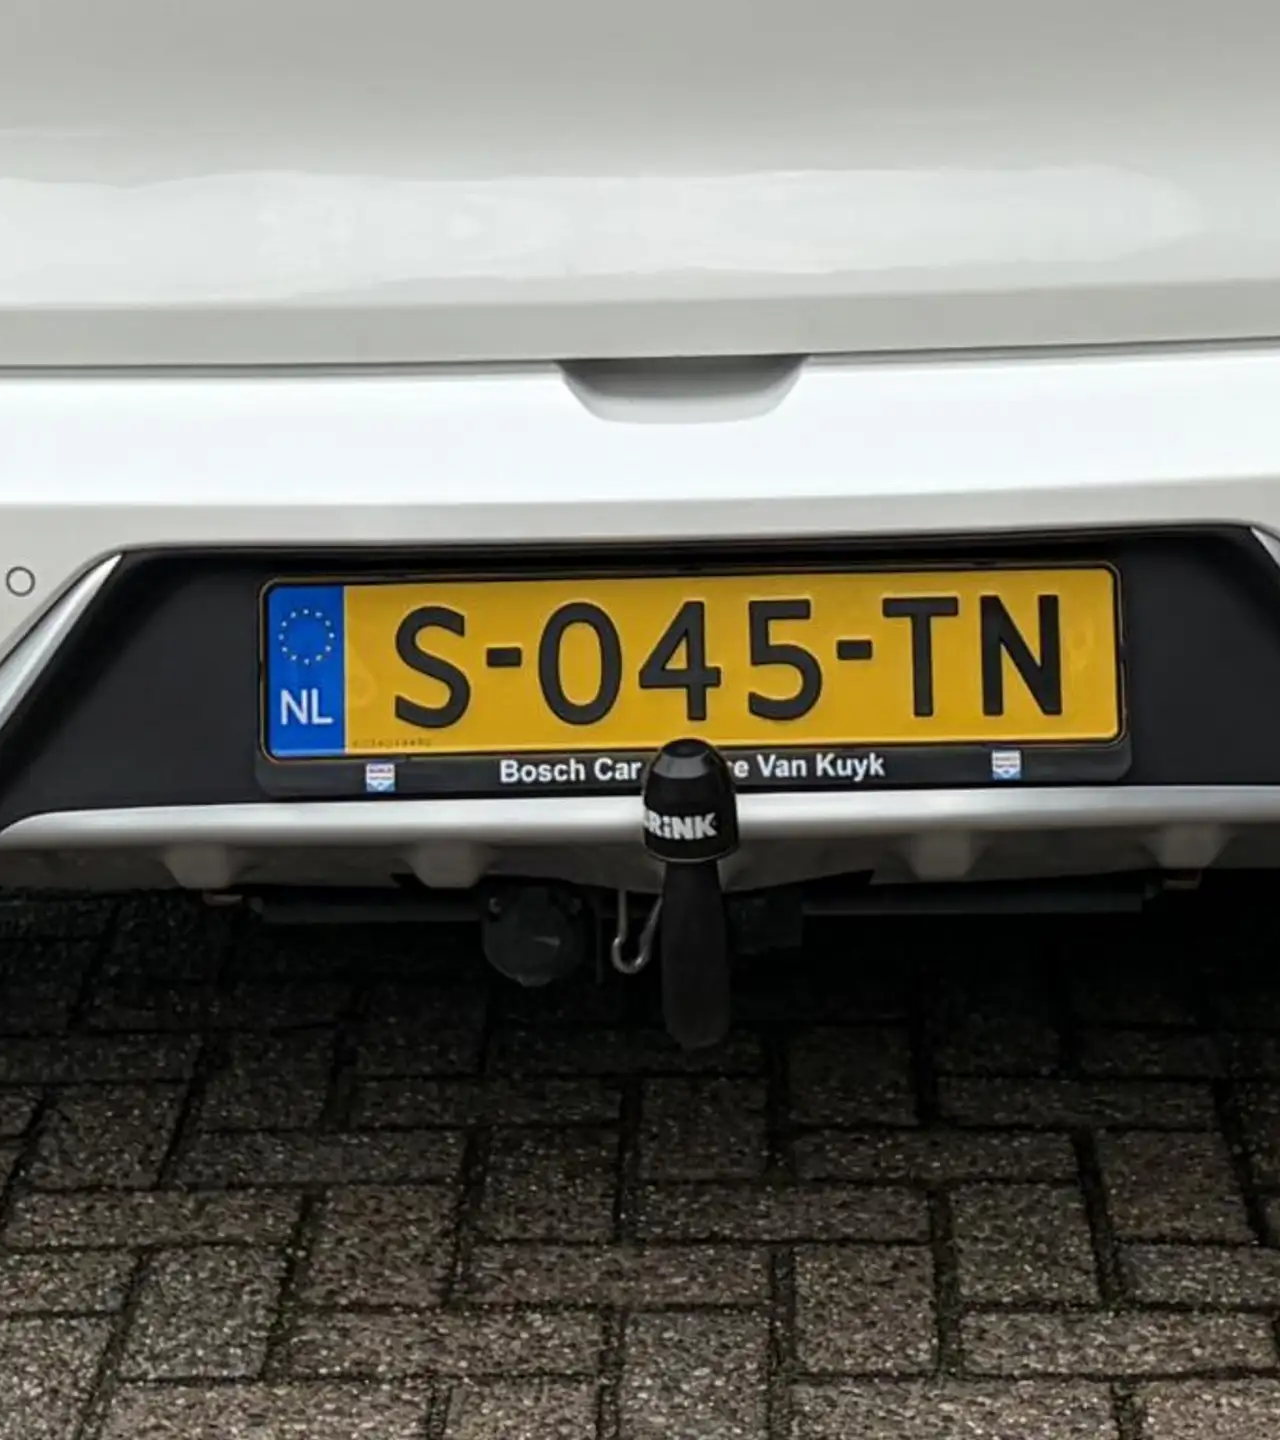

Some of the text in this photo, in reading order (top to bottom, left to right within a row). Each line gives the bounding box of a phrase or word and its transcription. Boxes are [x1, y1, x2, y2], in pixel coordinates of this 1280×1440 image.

[394, 593, 1063, 729] S-045-TN
[280, 687, 334, 725] NL
[499, 758, 586, 783] Bosch
[594, 758, 642, 781] Car
[756, 754, 807, 778] Van
[815, 752, 885, 781] Kuyk
